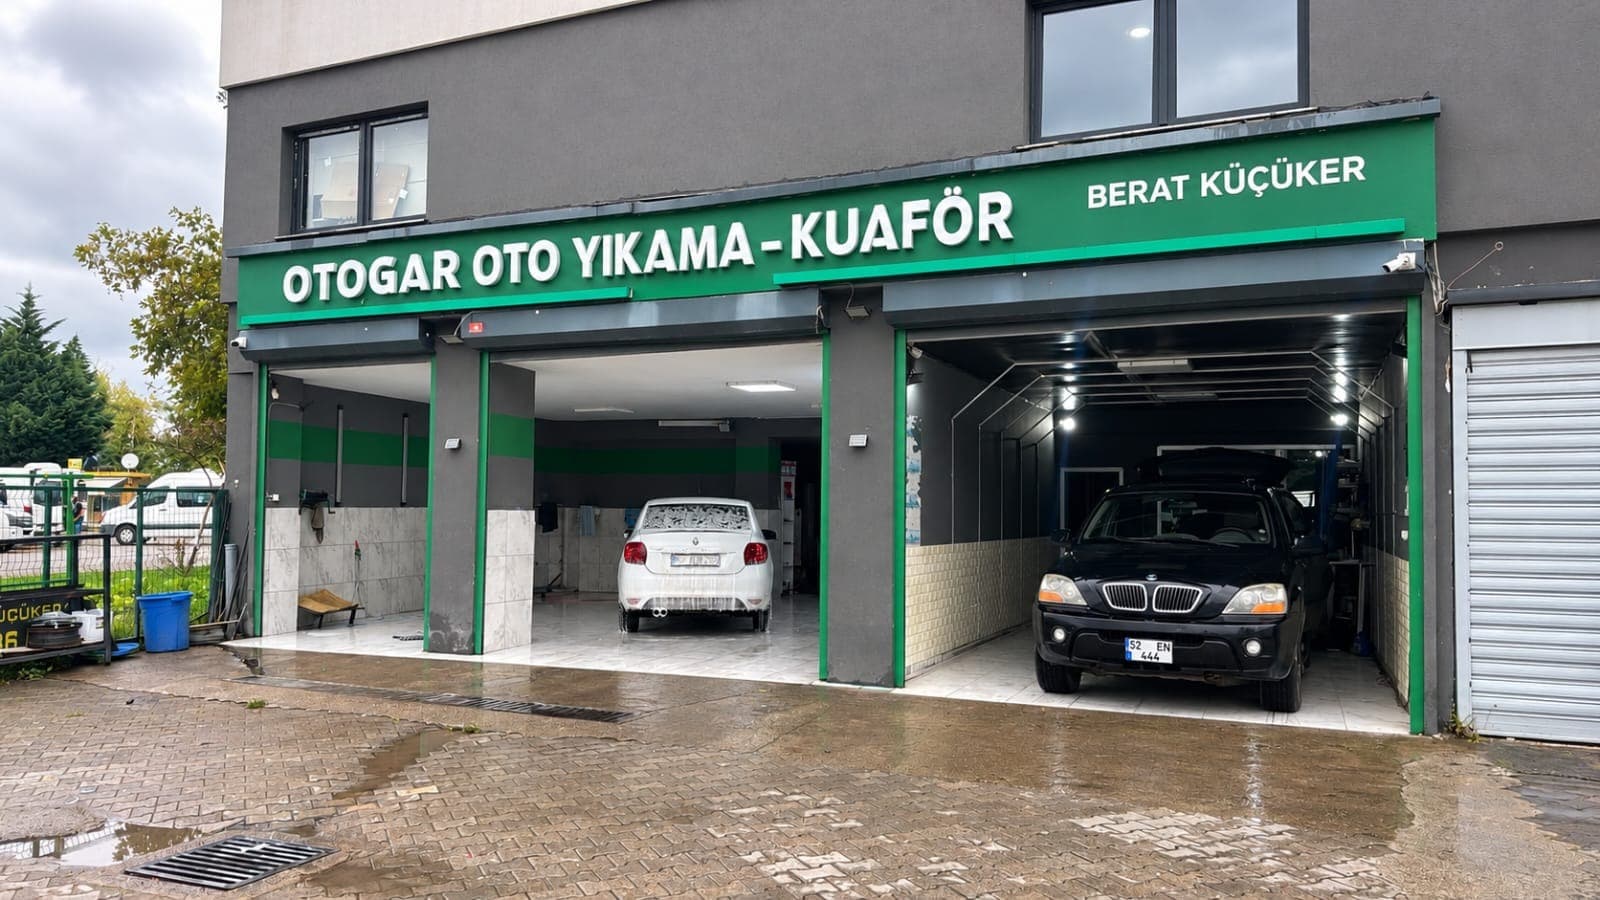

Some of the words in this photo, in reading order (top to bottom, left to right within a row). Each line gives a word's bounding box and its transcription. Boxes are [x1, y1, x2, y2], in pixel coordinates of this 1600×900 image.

[1087, 174, 1190, 209] BERAT
[1200, 155, 1367, 198] KÜÇÜKER
[282, 249, 461, 304] OTOGAR
[472, 239, 561, 287] OTO
[571, 221, 756, 279] YIKAMA
[791, 185, 1015, 260] KUAFÖR
[1130, 640, 1142, 650] 52
[1156, 642, 1171, 652] EN
[1140, 651, 1160, 661] 444
